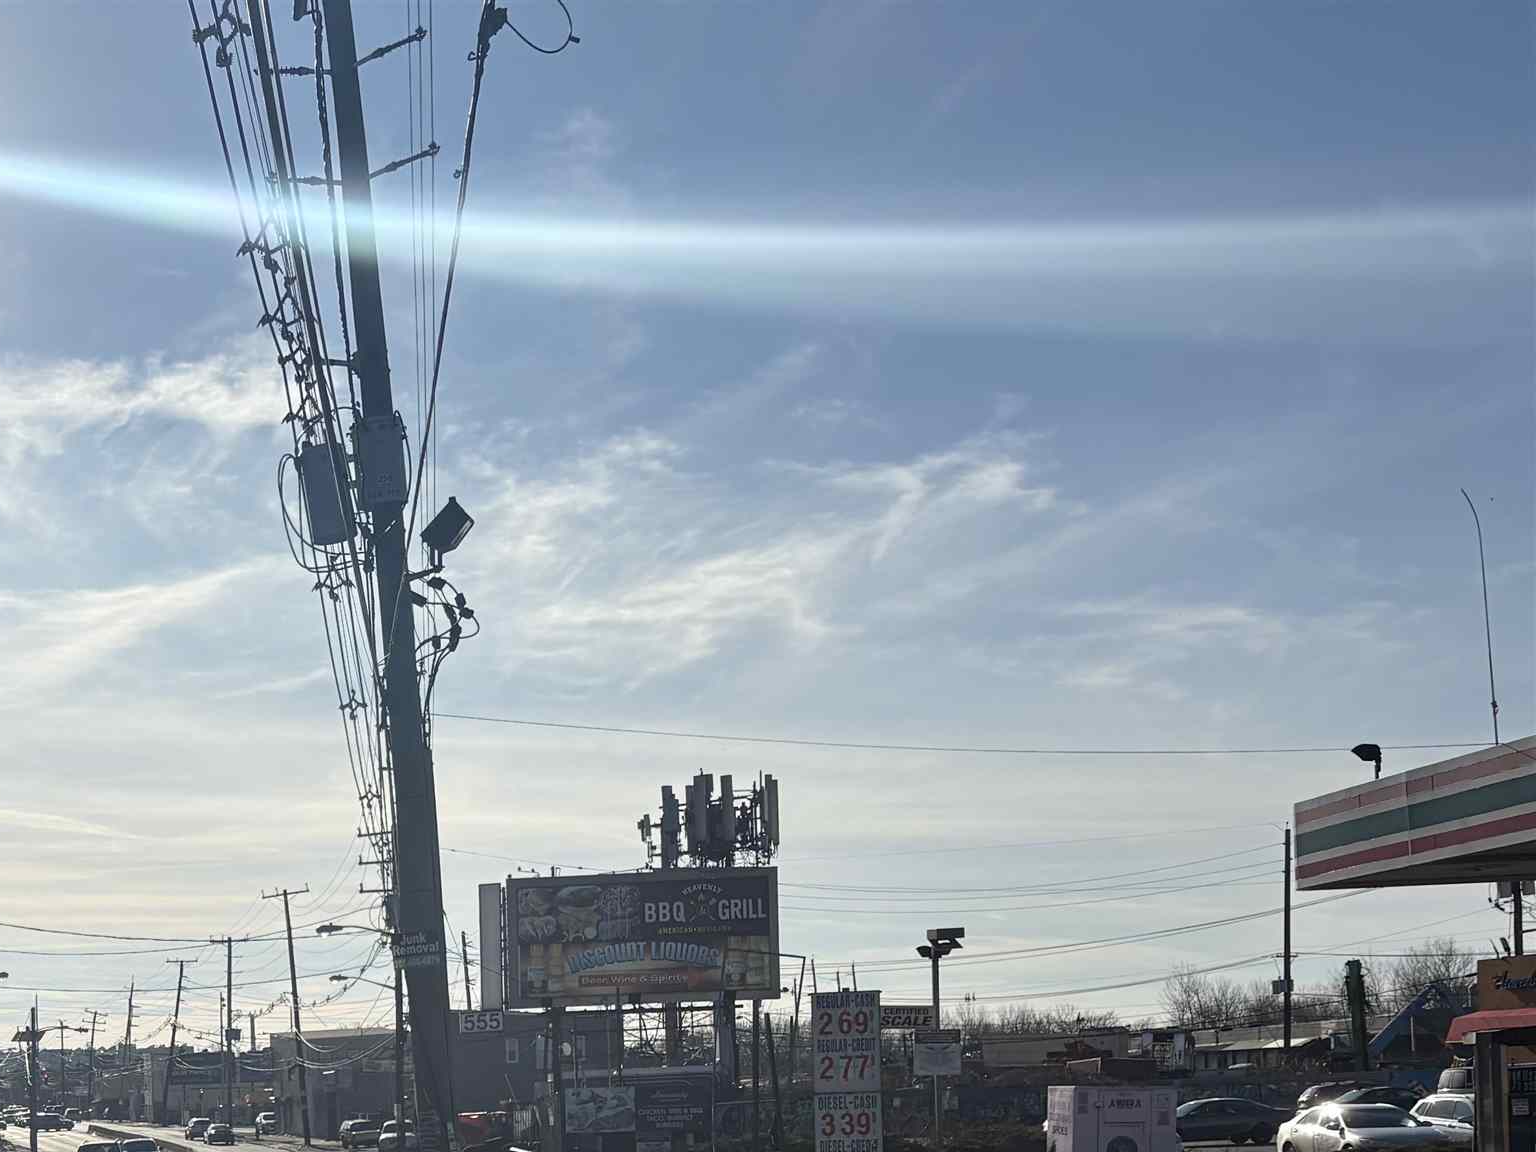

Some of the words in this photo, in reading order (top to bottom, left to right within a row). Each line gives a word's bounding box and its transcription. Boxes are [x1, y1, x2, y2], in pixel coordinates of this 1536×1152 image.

[644, 901, 686, 923] BBQ
[718, 898, 767, 921] GRILL
[400, 932, 426, 946] Junk
[392, 941, 440, 957] Removal
[567, 941, 647, 976] DISCOUNT
[651, 942, 722, 968] LIQUORS
[463, 1013, 500, 1031] 555
[881, 1015, 932, 1026] SCALE
